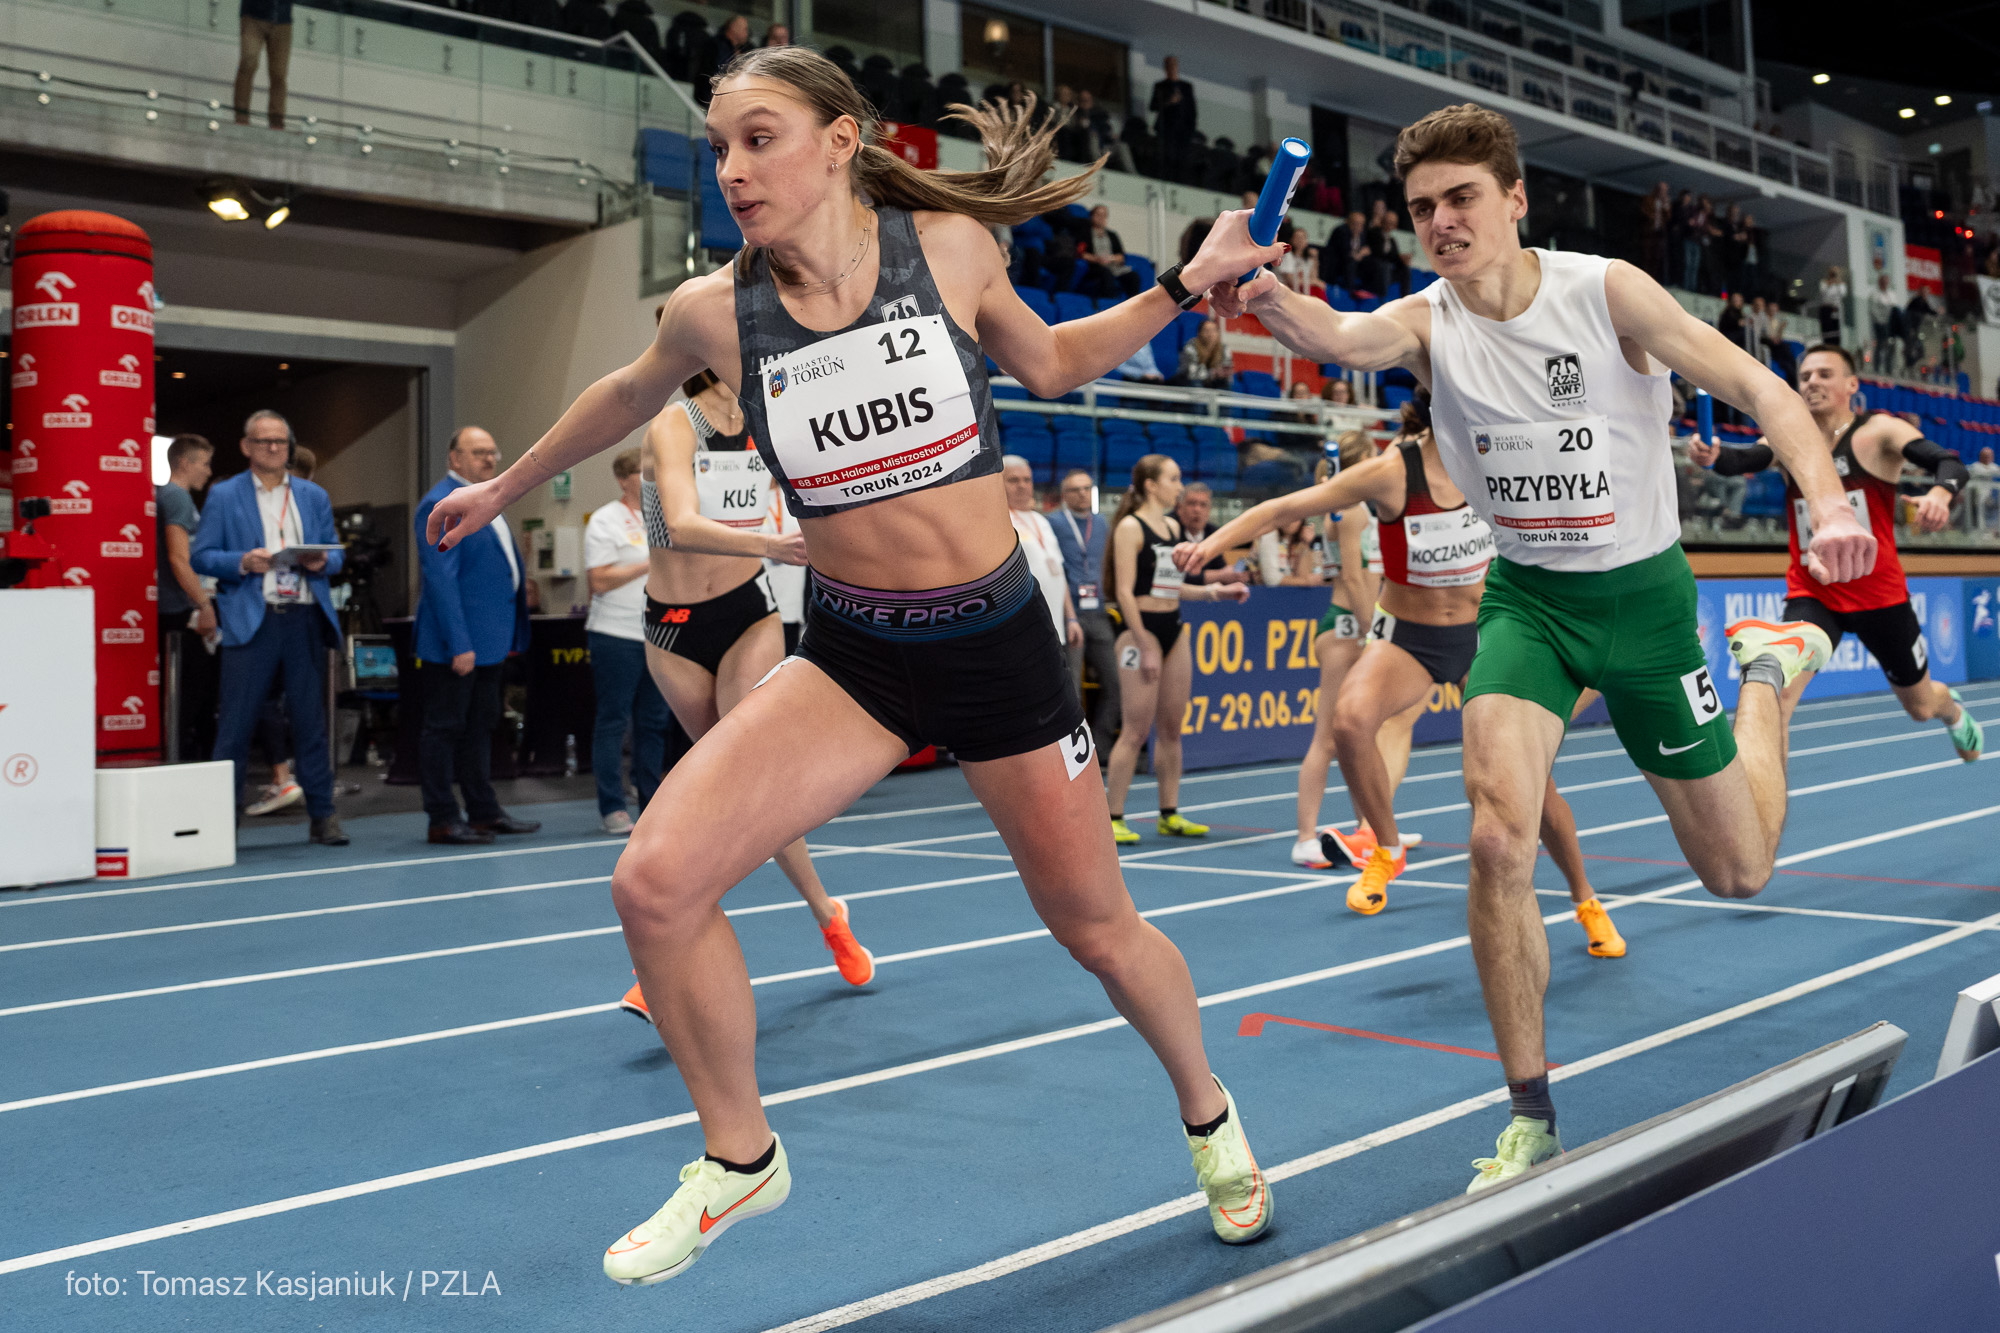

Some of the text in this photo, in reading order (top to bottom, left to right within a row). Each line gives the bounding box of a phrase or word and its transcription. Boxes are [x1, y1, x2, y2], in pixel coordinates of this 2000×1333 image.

[16, 307, 73, 324] ORLEN
[877, 328, 927, 365] 12
[791, 357, 846, 386] TORUŃ
[792, 355, 831, 373] MIASTO
[1551, 373, 1580, 387] AZS
[1552, 383, 1582, 397] AWF
[808, 387, 934, 452] KUBIS
[1494, 437, 1534, 452] TORUŃ
[1558, 427, 1593, 453] 20
[748, 456, 766, 472] 48
[797, 428, 972, 488] 68. PZLA Halowe Mistrzostwa Polski
[840, 461, 943, 498] TORUŃ 2024
[1486, 470, 1611, 502] PRZYBYŁA
[723, 484, 758, 509] KUŚ
[1518, 520, 1547, 528] Halowe
[1547, 517, 1594, 527] Mistrzostwa
[1594, 514, 1614, 525] Polski
[1517, 530, 1590, 543] TORUŃ 2024
[660, 608, 691, 624] NB
[819, 591, 988, 628] NIKE PRO
[1342, 616, 1354, 636] 3
[1373, 616, 1386, 639] 4
[1126, 648, 1138, 667] 2
[1184, 620, 1253, 675] 00.
[1696, 669, 1718, 714] 5
[1070, 725, 1090, 764] 5
